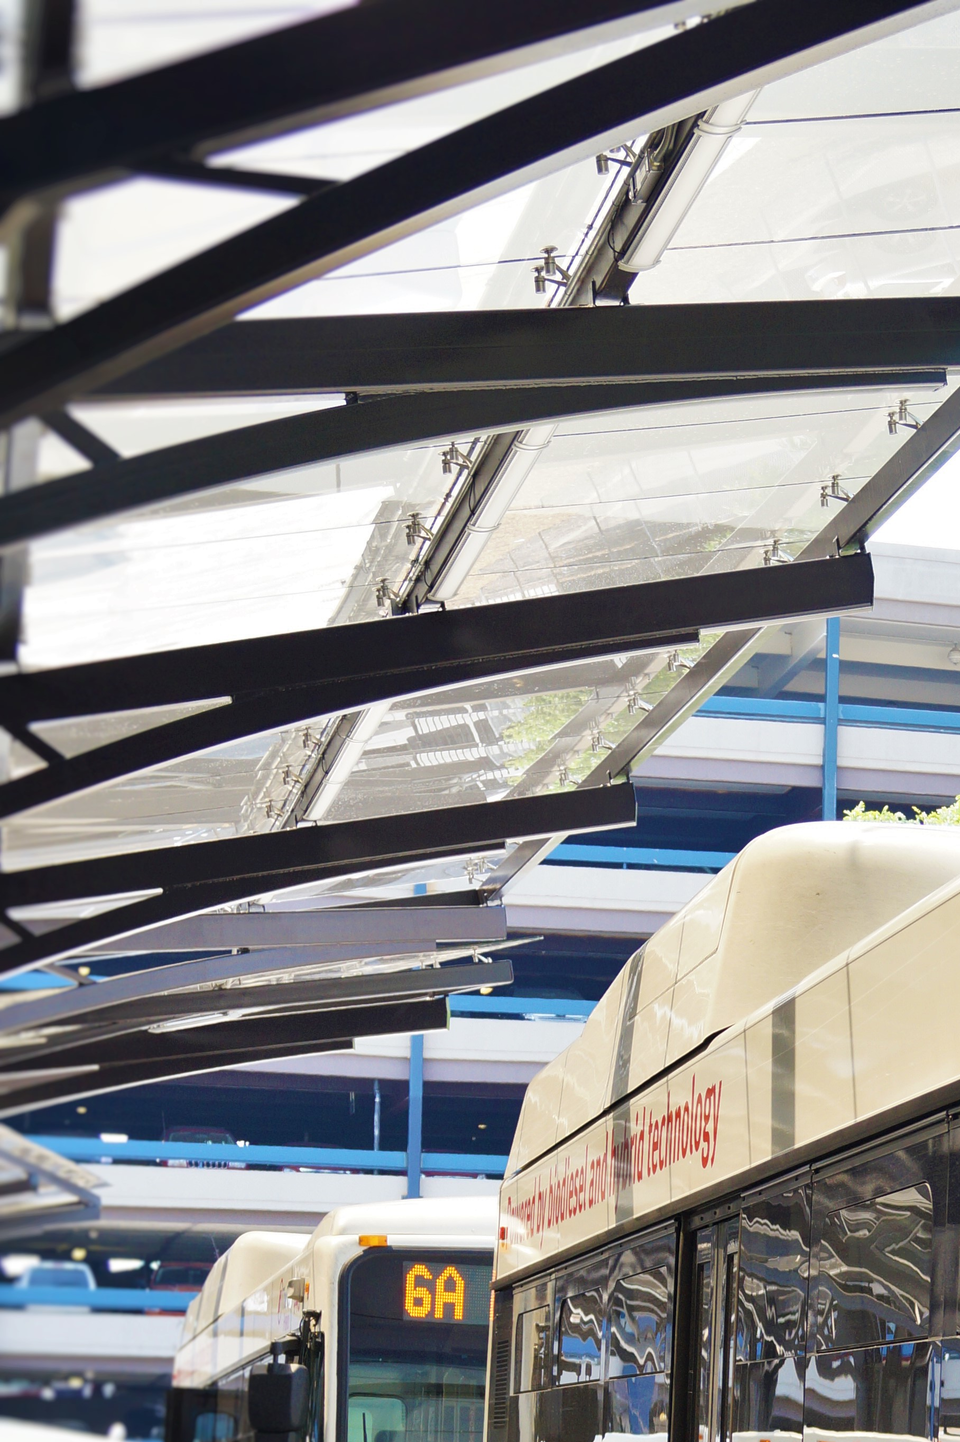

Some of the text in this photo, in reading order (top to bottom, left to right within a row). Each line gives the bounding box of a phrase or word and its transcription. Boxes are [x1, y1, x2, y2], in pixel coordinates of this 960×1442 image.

[537, 1172, 548, 1250] by
[547, 1143, 588, 1229] biodiesel
[588, 1130, 608, 1209] and
[607, 1106, 646, 1214] hybrid
[646, 1073, 722, 1178] technology
[404, 1263, 465, 1320] 6A
